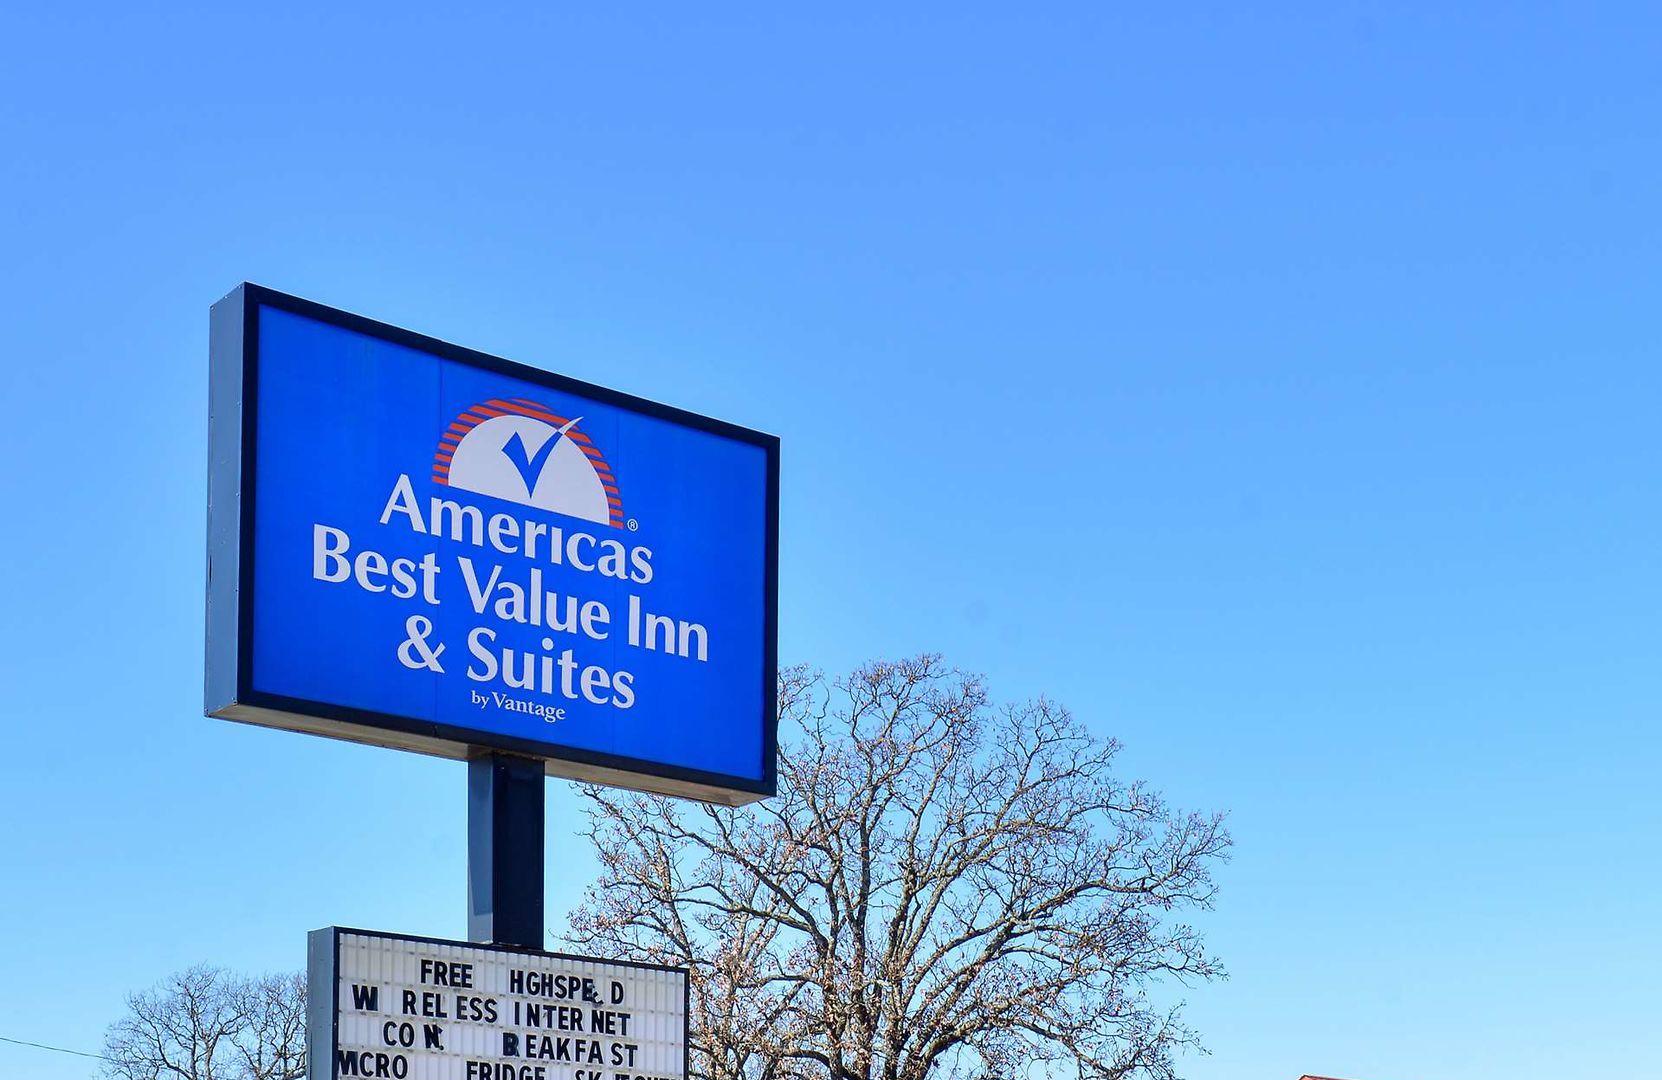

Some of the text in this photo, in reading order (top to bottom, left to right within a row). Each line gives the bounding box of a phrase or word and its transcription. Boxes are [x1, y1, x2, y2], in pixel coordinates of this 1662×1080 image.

[380, 473, 654, 584] Americas
[313, 524, 708, 661] Best Value Inn
[397, 614, 635, 709] & Suites
[471, 690, 566, 723] by Vantage
[420, 959, 473, 988] FREE
[514, 1001, 631, 1036] INTERNET
